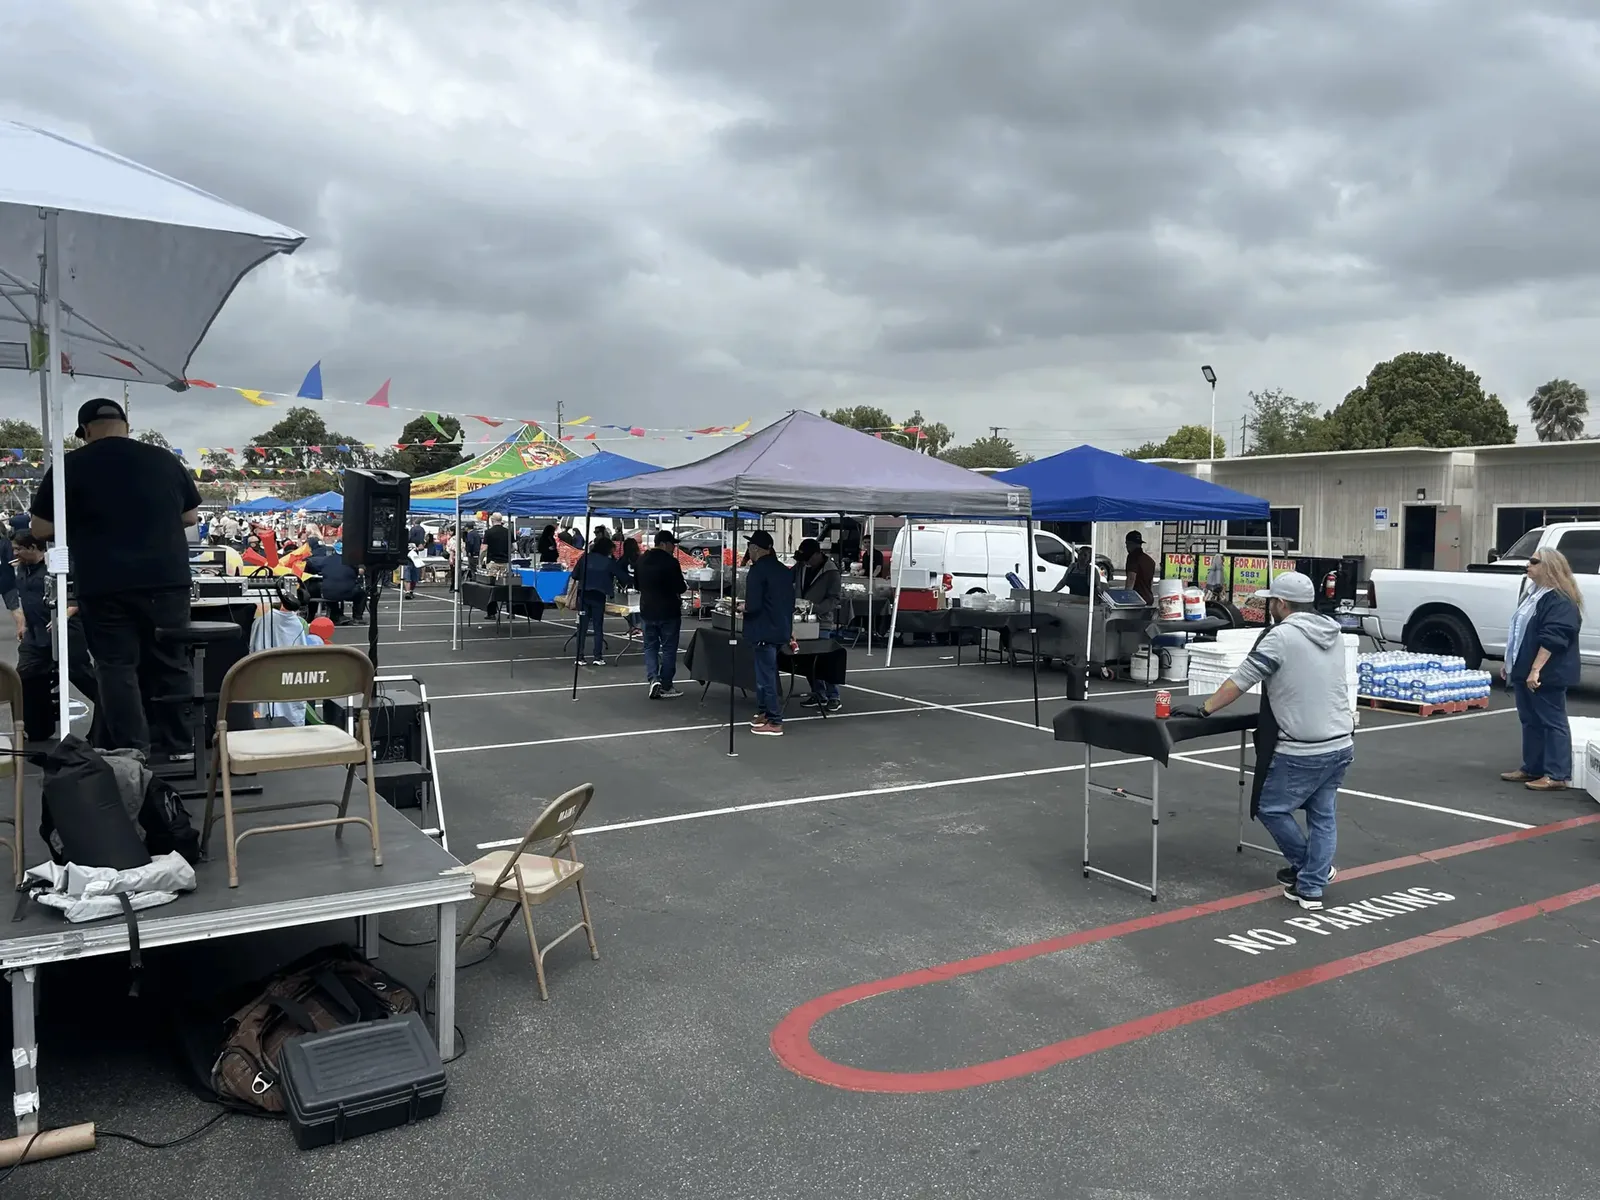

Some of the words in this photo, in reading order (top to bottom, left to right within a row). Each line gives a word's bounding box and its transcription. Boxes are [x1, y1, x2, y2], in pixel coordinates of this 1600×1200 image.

[1168, 554, 1193, 565] TACO
[1234, 557, 1249, 568] FOR
[1251, 559, 1268, 570] ANY
[1273, 560, 1296, 570] EVENT
[281, 670, 330, 685] MAINT.
[1213, 928, 1298, 955] NO
[1284, 886, 1456, 936] PARKING
